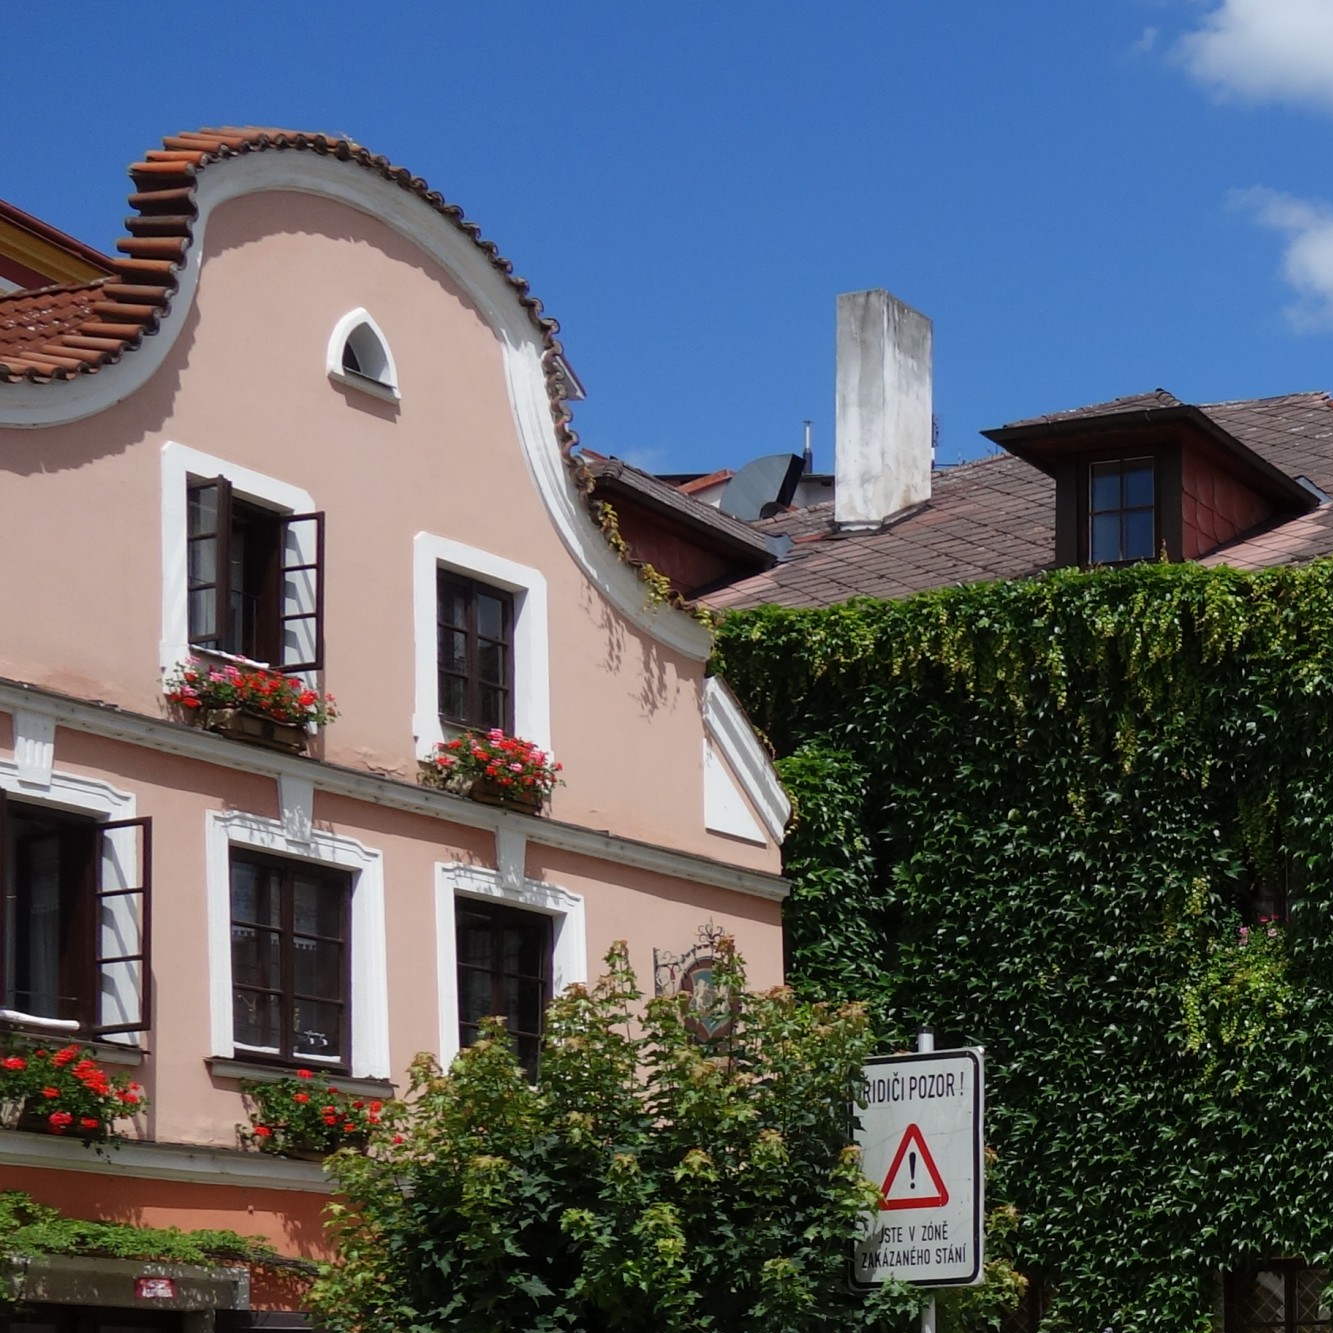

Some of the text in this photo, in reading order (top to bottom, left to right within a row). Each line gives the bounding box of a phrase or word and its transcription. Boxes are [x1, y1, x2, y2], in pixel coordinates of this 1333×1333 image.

[909, 1072, 955, 1101] POZOR
[878, 1220, 949, 1244] JSTE V ZÓNĚ
[861, 1242, 967, 1269] ZAKÁZANÉHO STÁNÍ
